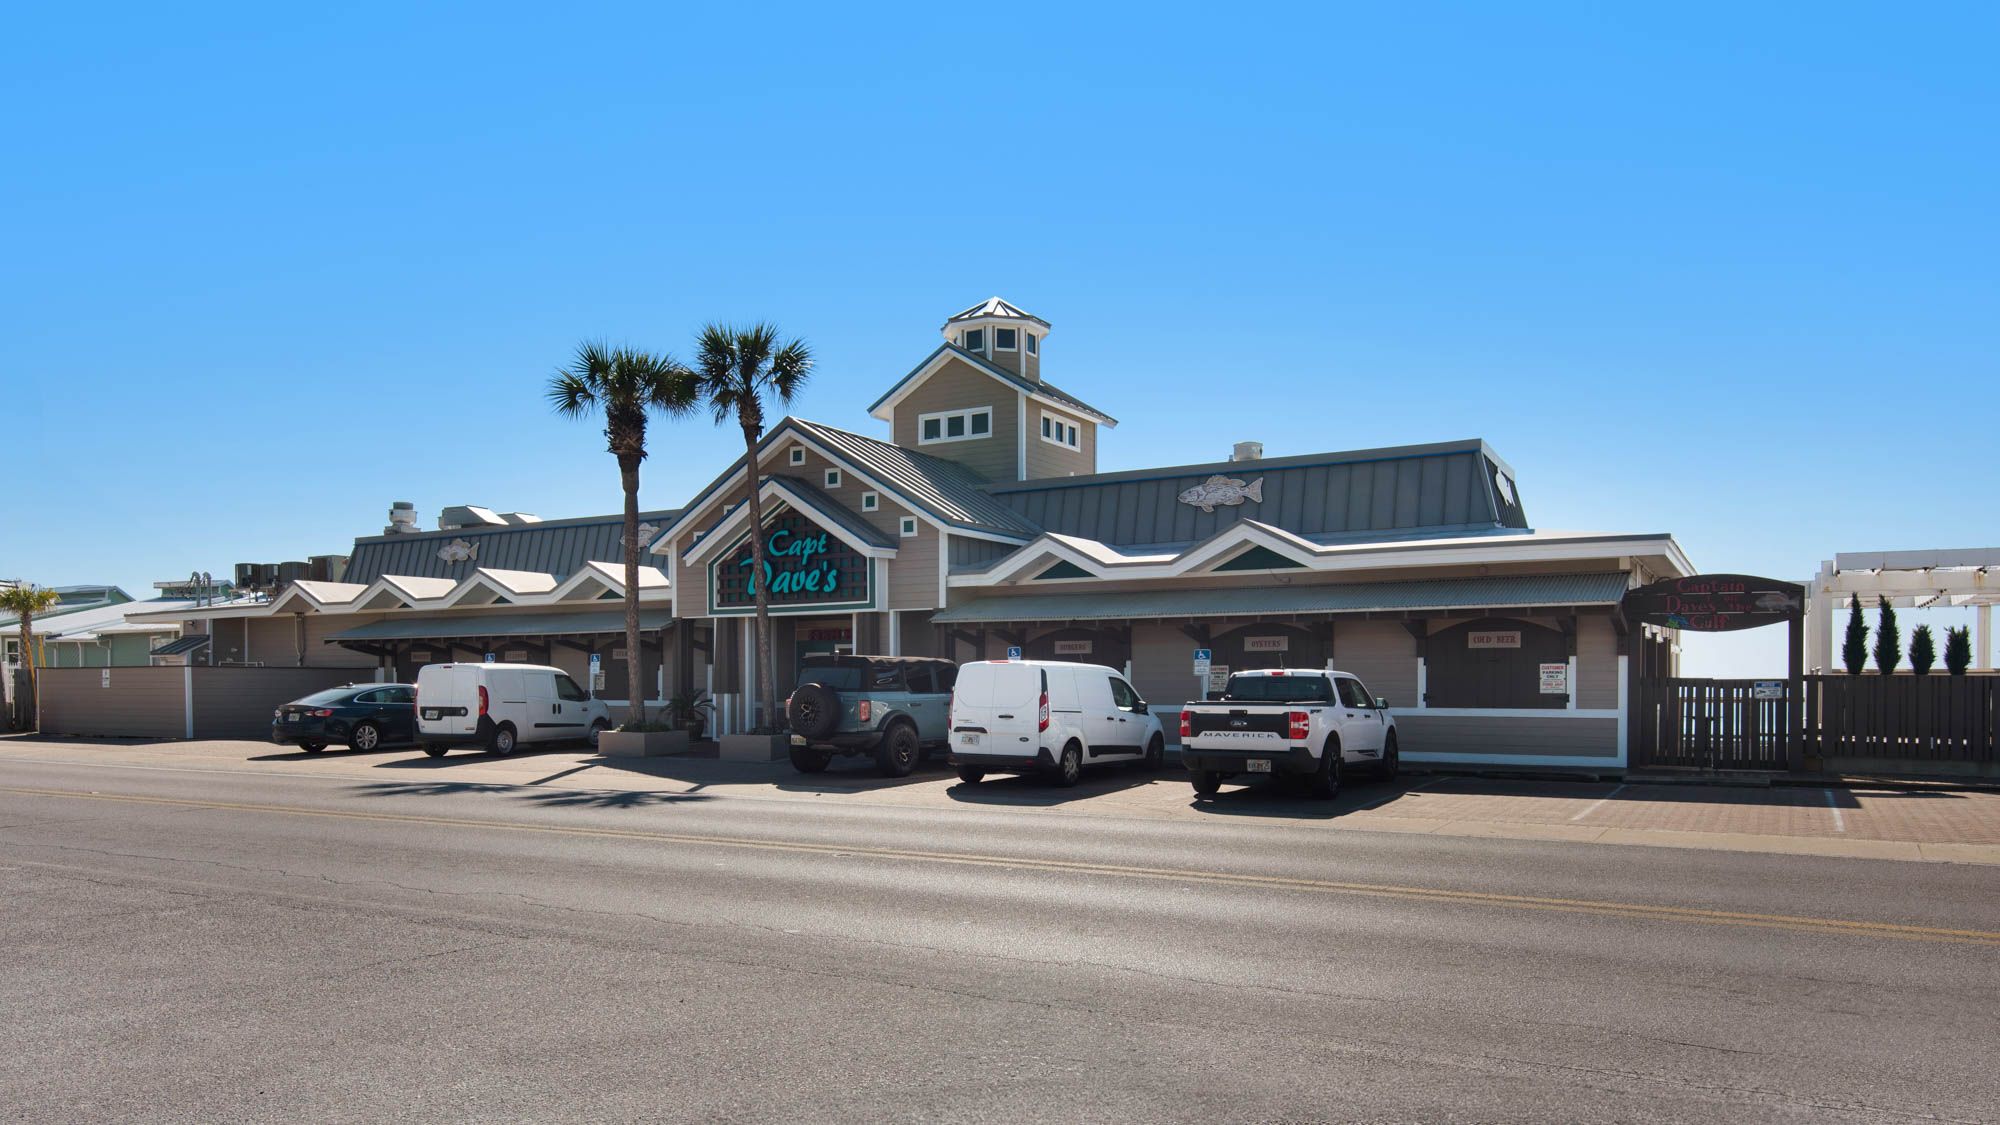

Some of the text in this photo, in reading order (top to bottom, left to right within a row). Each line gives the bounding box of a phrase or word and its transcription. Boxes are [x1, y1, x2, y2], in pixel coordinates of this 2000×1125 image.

[768, 529, 827, 565] Capt
[739, 557, 838, 596] Dave's
[1676, 579, 1745, 593] Captain
[1689, 614, 1729, 628] Gulf
[1251, 640, 1281, 648] OYSTERS
[1473, 635, 1516, 643] COLD BEER
